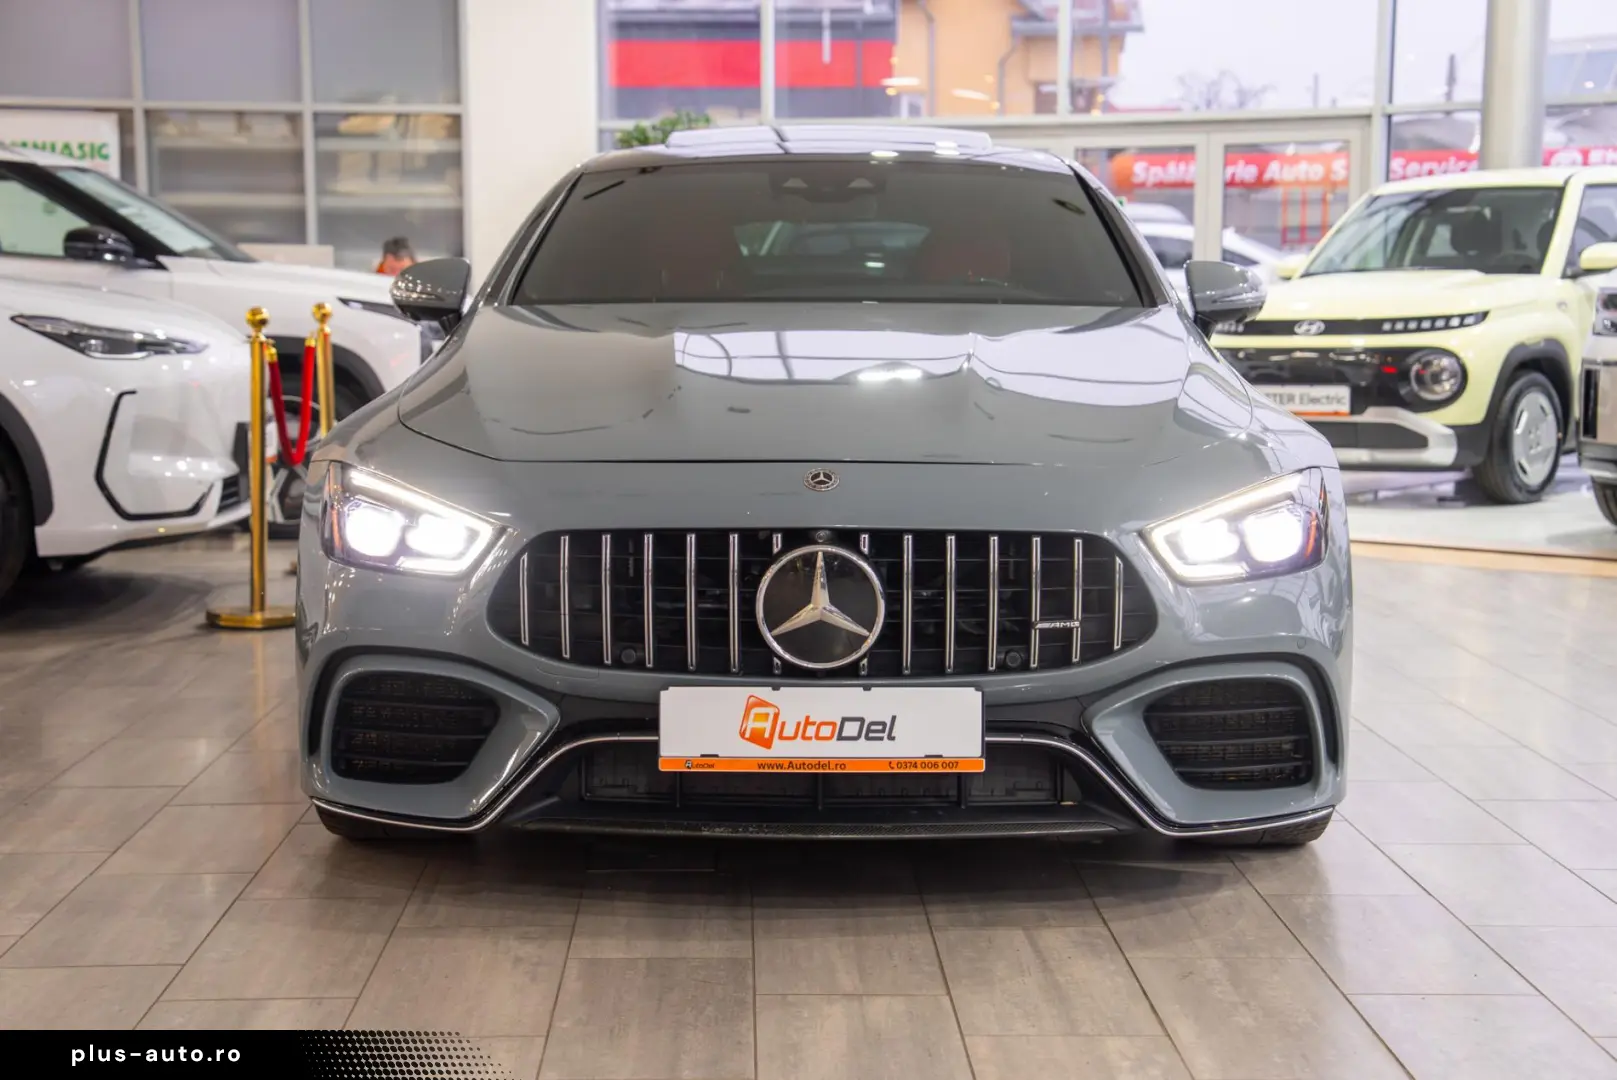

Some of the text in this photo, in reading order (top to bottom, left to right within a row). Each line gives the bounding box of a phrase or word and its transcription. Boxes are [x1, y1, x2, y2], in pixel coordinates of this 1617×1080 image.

[1263, 159, 1325, 182] Auto
[1299, 392, 1347, 405] Electric
[1051, 621, 1080, 629] AMG
[742, 702, 897, 743] AutoDel
[757, 760, 847, 771] www.Autodel.ro
[896, 761, 959, 770] 0374 006 007
